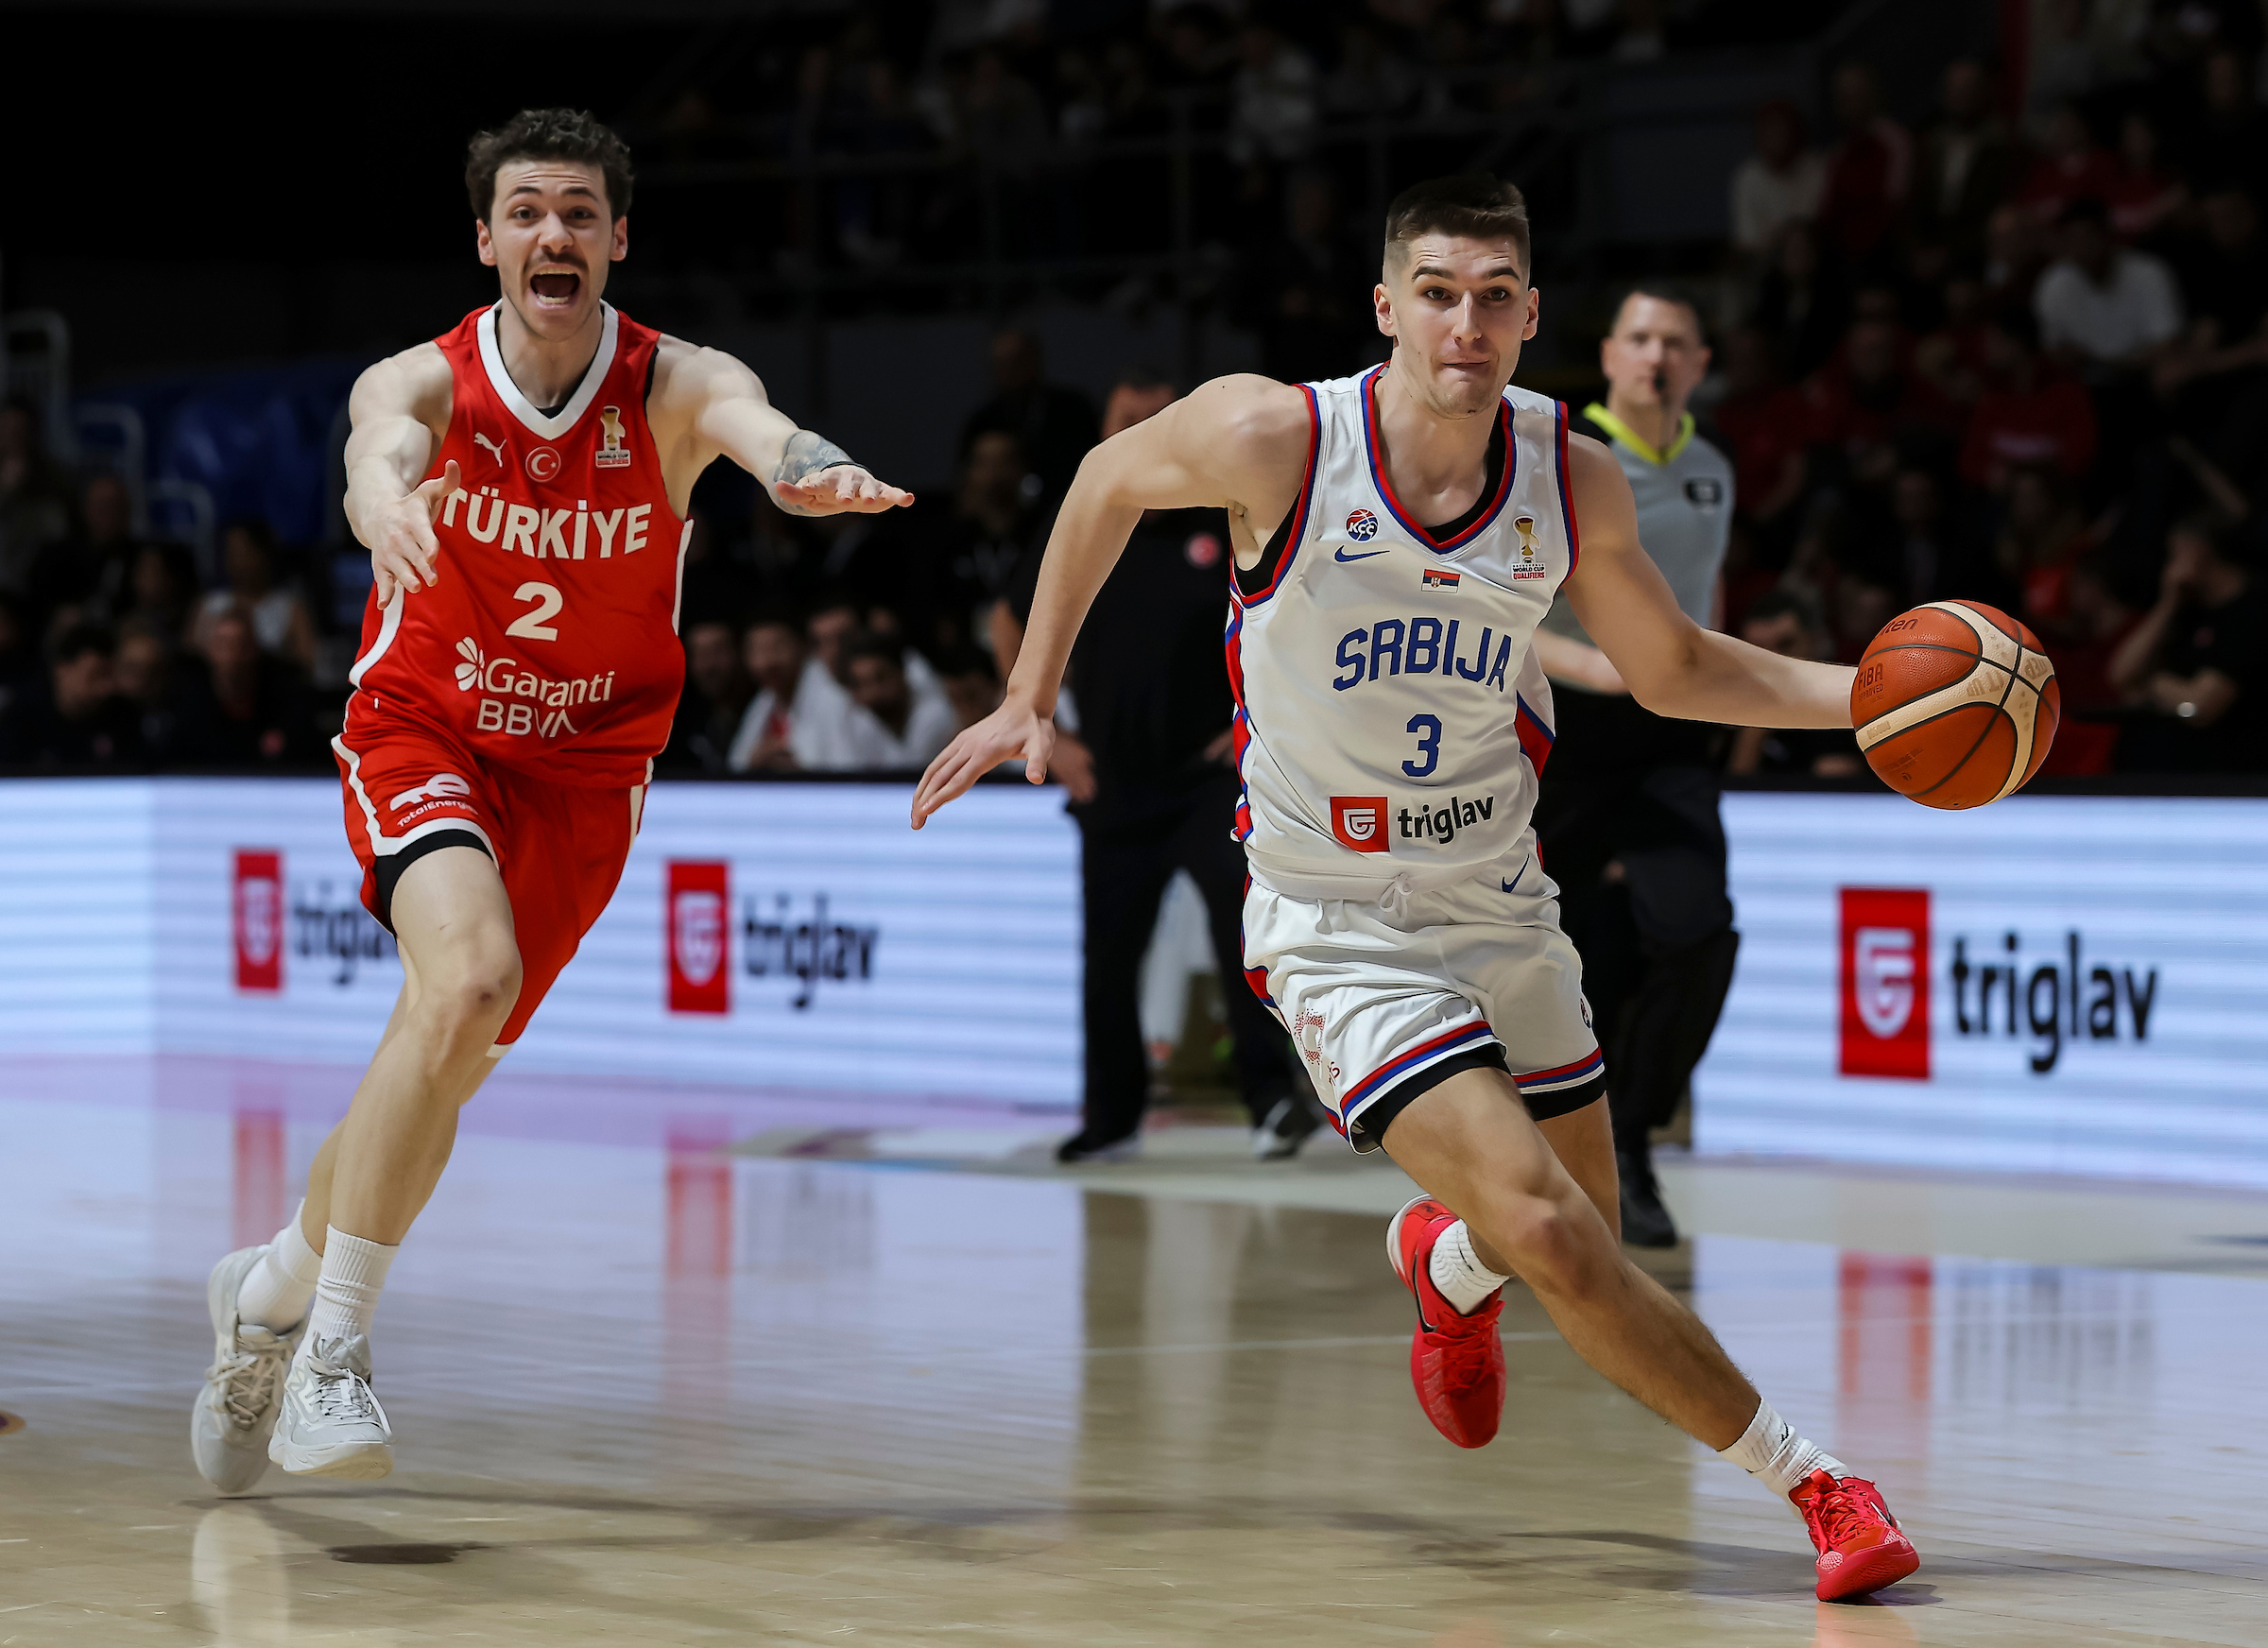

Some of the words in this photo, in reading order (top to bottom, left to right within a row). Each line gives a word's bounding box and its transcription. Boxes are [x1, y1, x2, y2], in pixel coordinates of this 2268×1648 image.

[442, 486, 652, 560] TÜRKİYE
[505, 581, 564, 643] 2
[485, 658, 616, 708] Garanti
[1332, 617, 1512, 693] SRBIJA
[1858, 662, 1883, 692] FIBA
[476, 698, 579, 739] BBVA
[1401, 713, 1443, 778] 3
[1397, 796, 1494, 845] triglav
[744, 890, 879, 1013] triglav
[1952, 930, 2157, 1074] triglav
